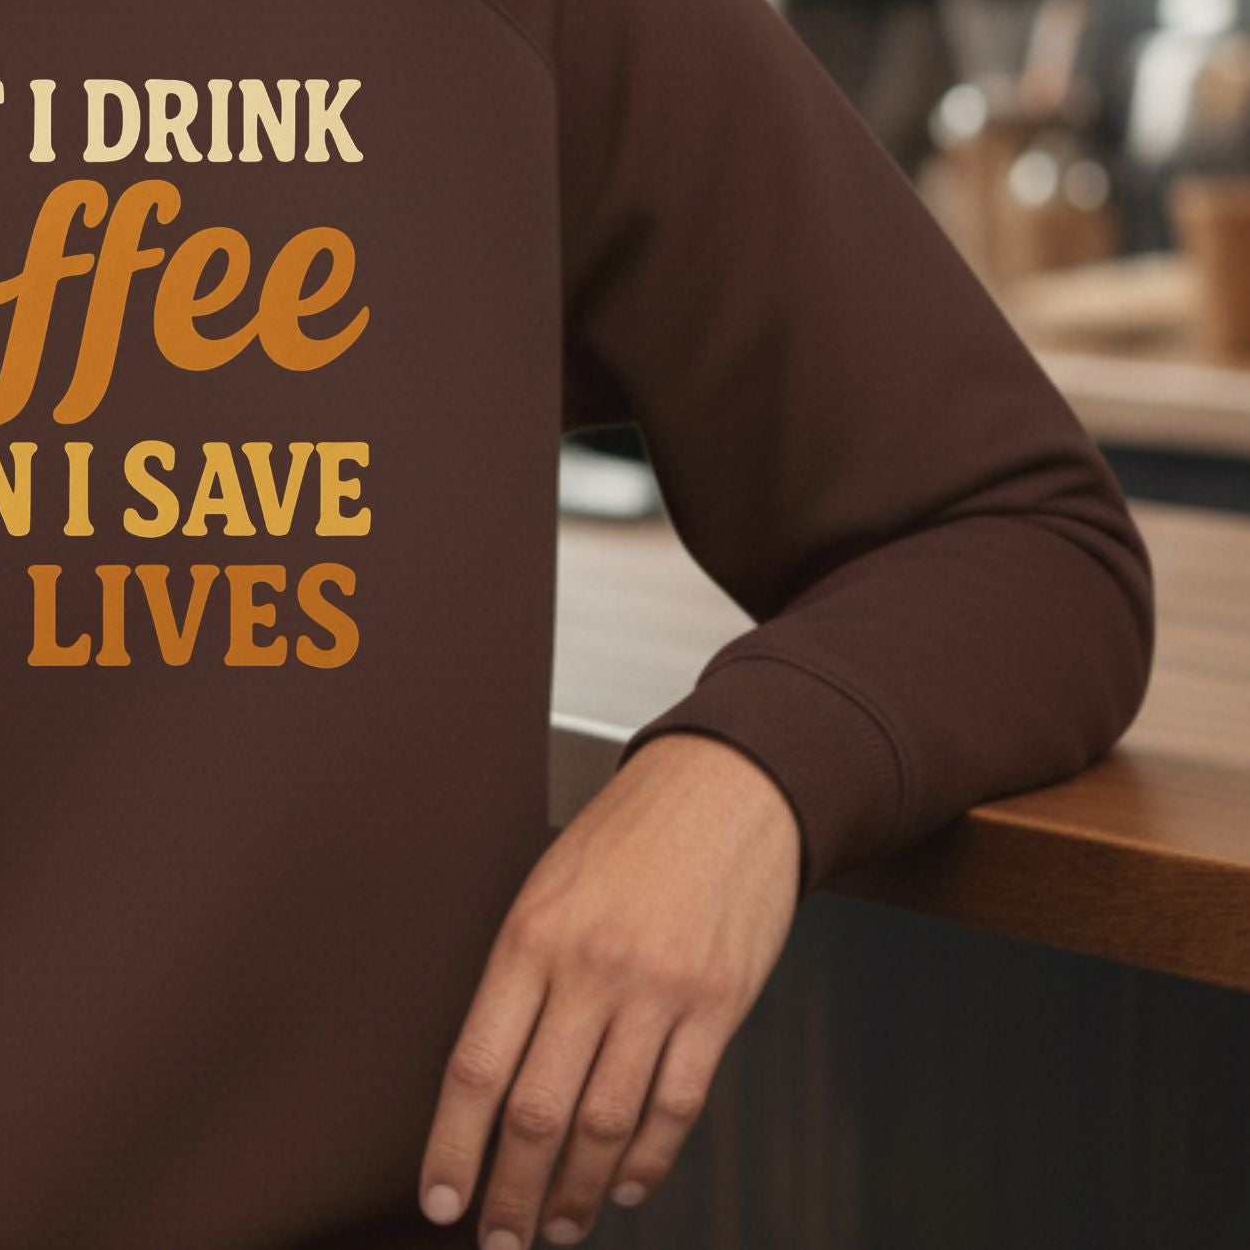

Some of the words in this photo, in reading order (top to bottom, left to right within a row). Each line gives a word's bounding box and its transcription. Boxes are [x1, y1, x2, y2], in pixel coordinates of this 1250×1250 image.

[30, 79, 56, 162] I
[83, 79, 363, 162] DRINK
[64, 442, 94, 536] I
[123, 440, 372, 538] SAVE
[28, 563, 359, 669] LIVES
